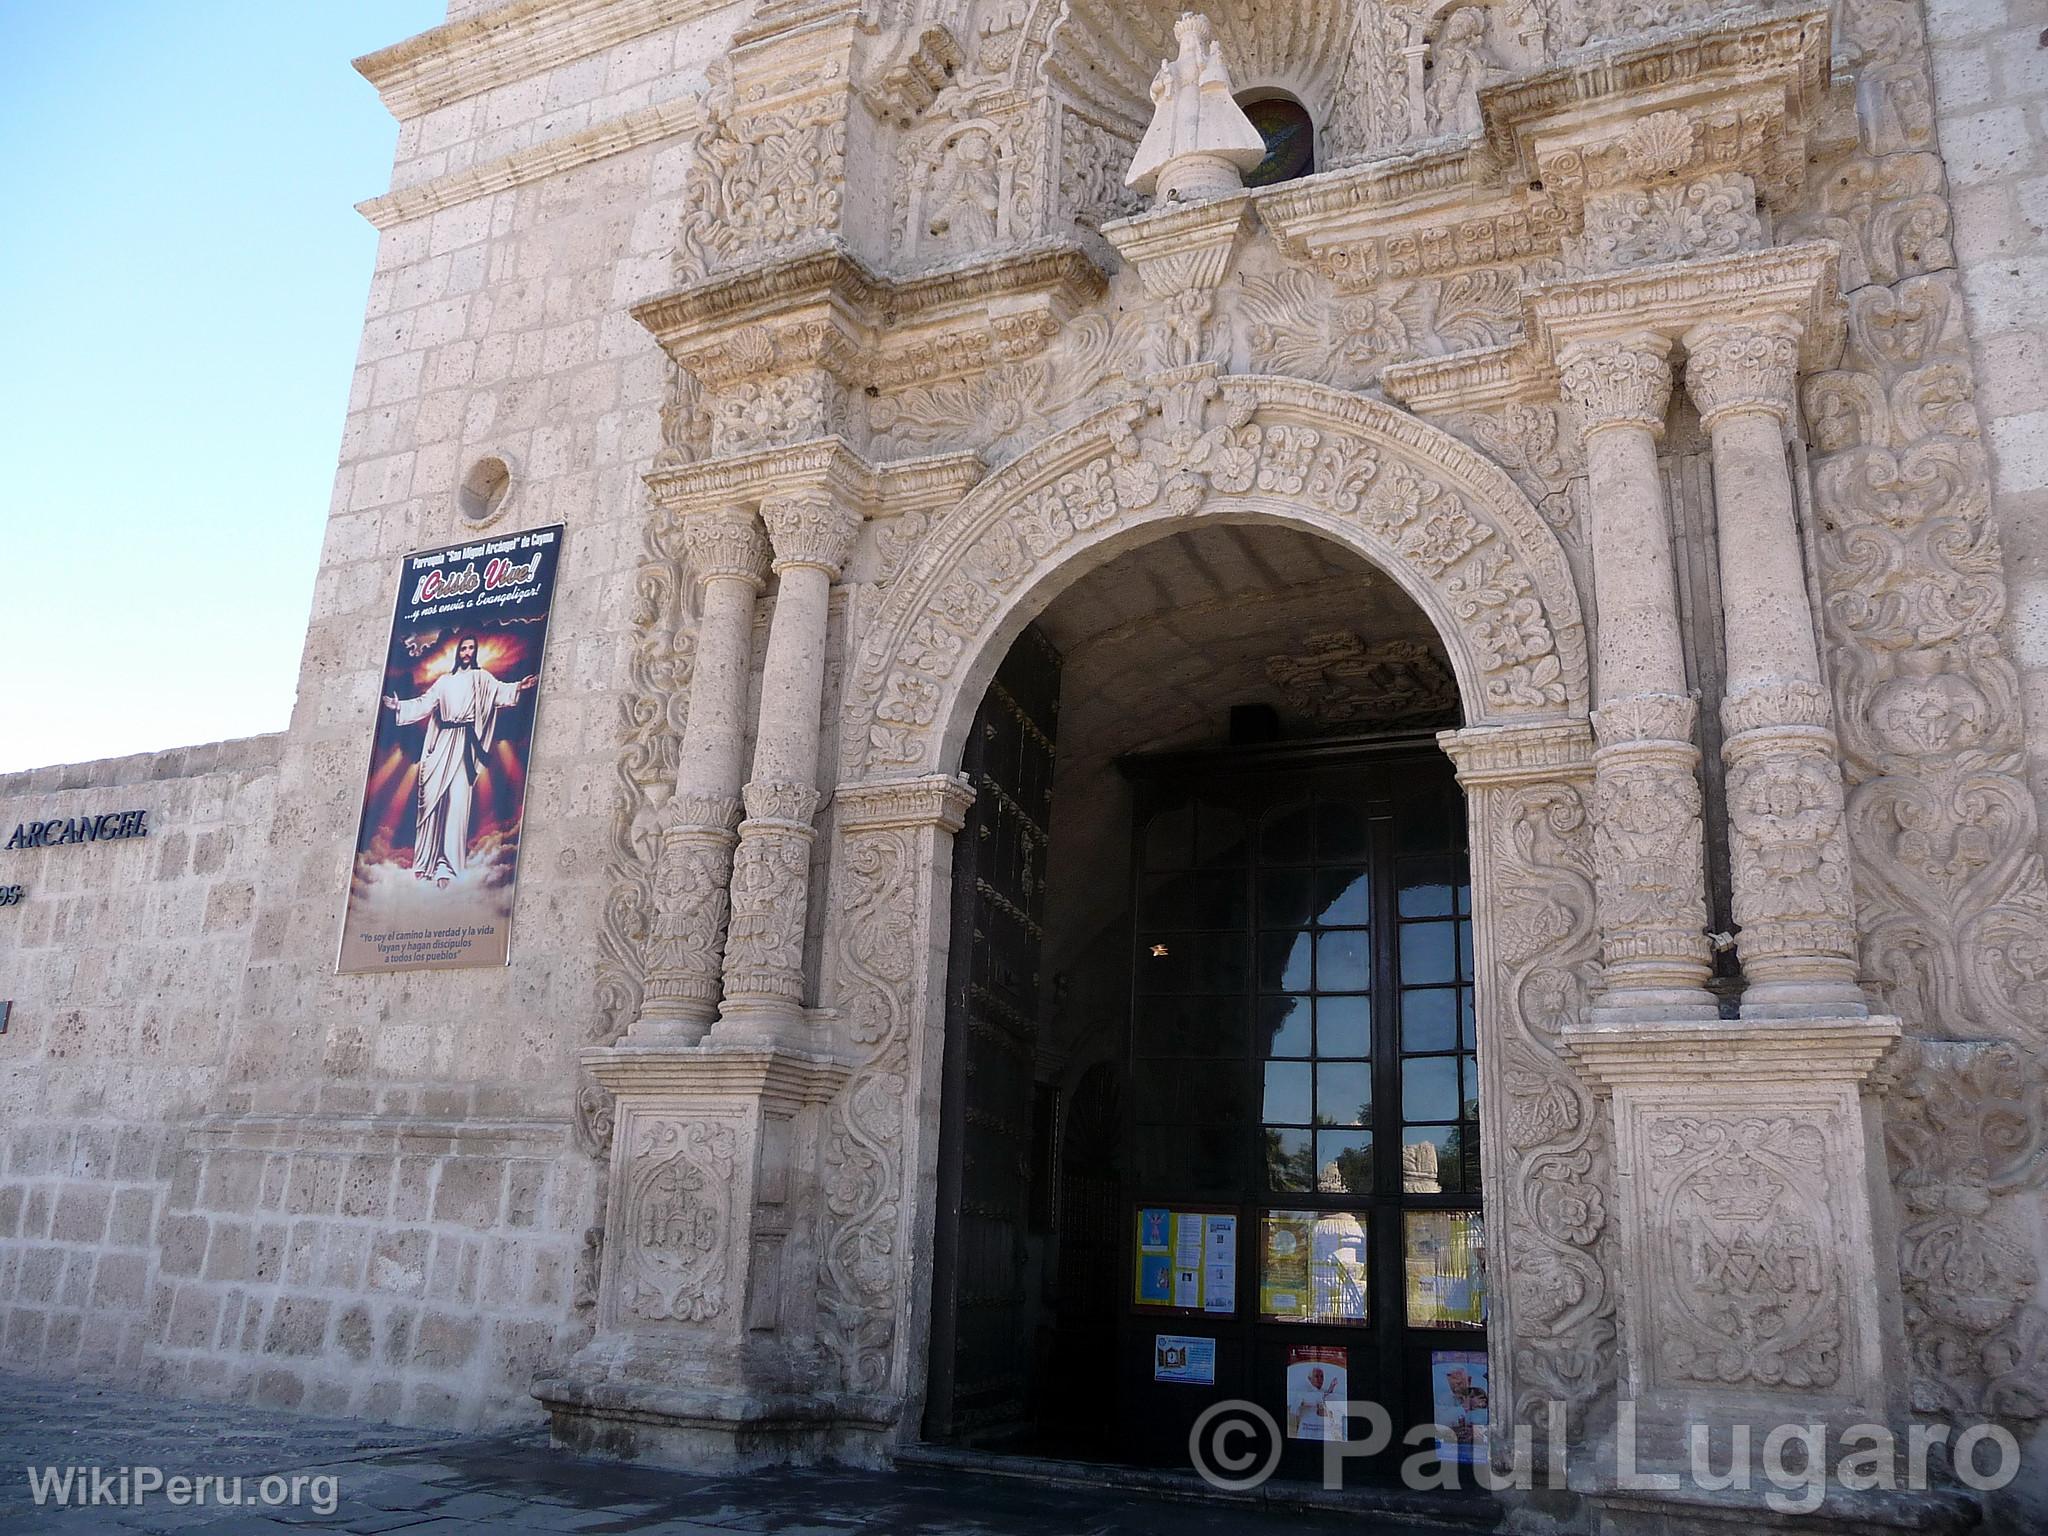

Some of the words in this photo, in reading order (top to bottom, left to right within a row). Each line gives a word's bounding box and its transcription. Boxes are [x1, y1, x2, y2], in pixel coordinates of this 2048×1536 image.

[462, 543, 484, 560] Miguel
[521, 536, 530, 547] de
[484, 552, 541, 590] Vive!
[421, 604, 437, 617] nos
[4, 810, 148, 850] ARCANGEL
[373, 934, 386, 944] soy
[387, 930, 395, 941] el
[396, 931, 423, 941] camino
[424, 929, 432, 939] la
[433, 927, 460, 939] verdad
[461, 929, 467, 938] y
[468, 926, 476, 937] la
[477, 925, 495, 936] vida
[377, 943, 400, 953] Vayan
[401, 942, 408, 952] y
[408, 941, 431, 953] hagan
[413, 951, 425, 962] los
